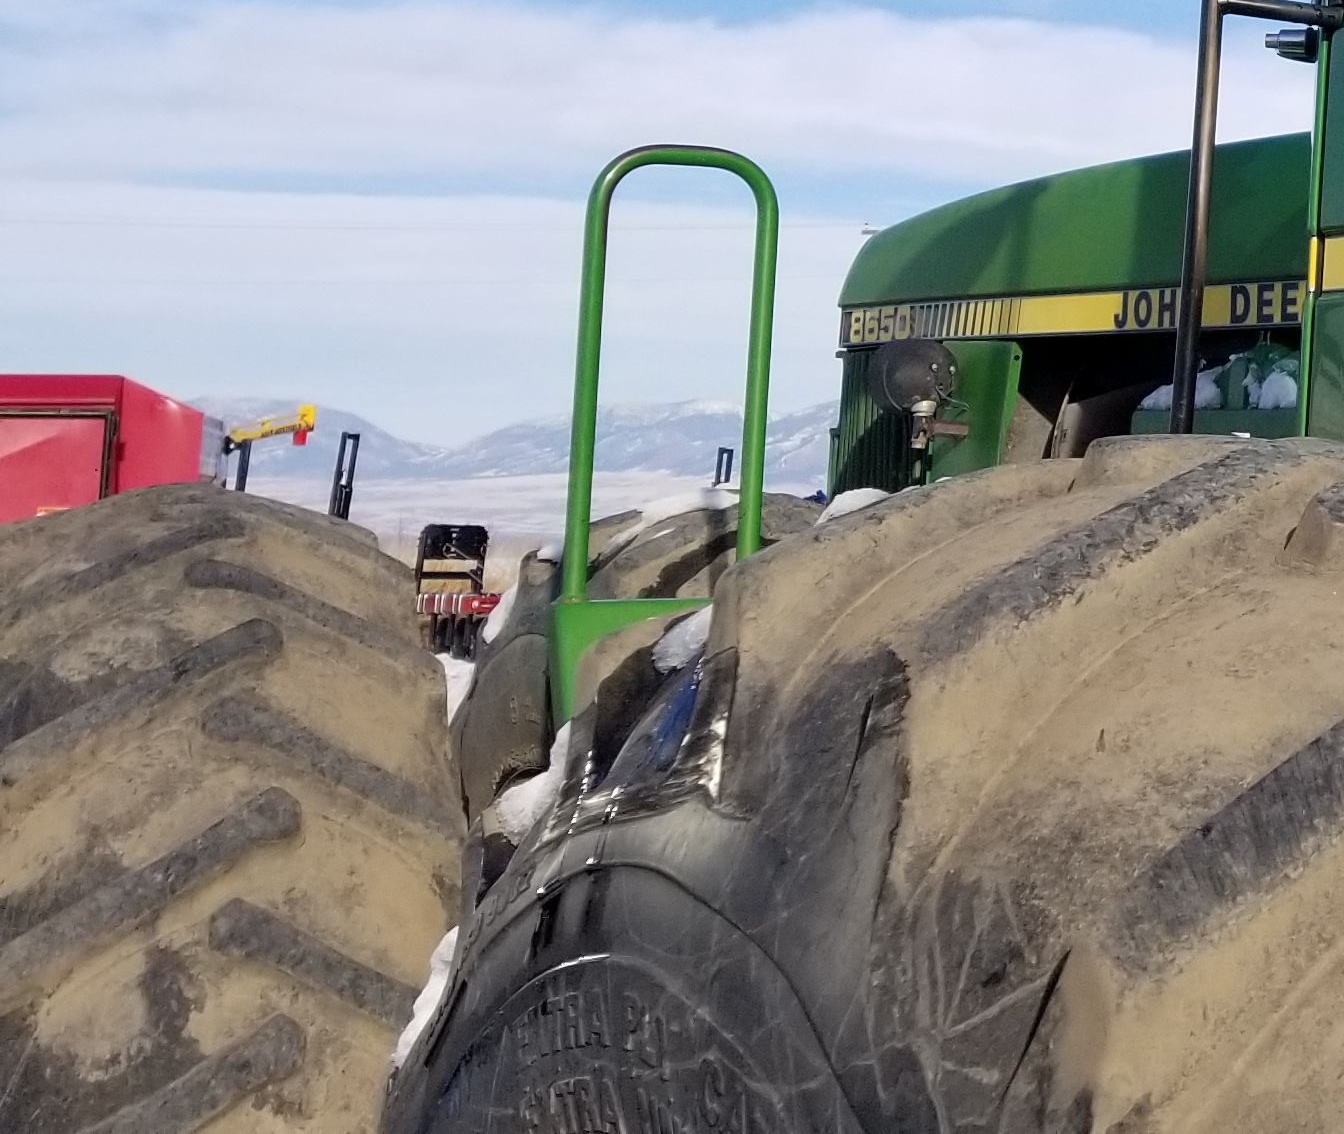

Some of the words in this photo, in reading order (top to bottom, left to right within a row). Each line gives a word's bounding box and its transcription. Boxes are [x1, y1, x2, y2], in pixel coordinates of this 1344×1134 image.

[850, 306, 911, 343] 8650
[1113, 288, 1177, 329] JOH
[1230, 282, 1299, 324] DEE
